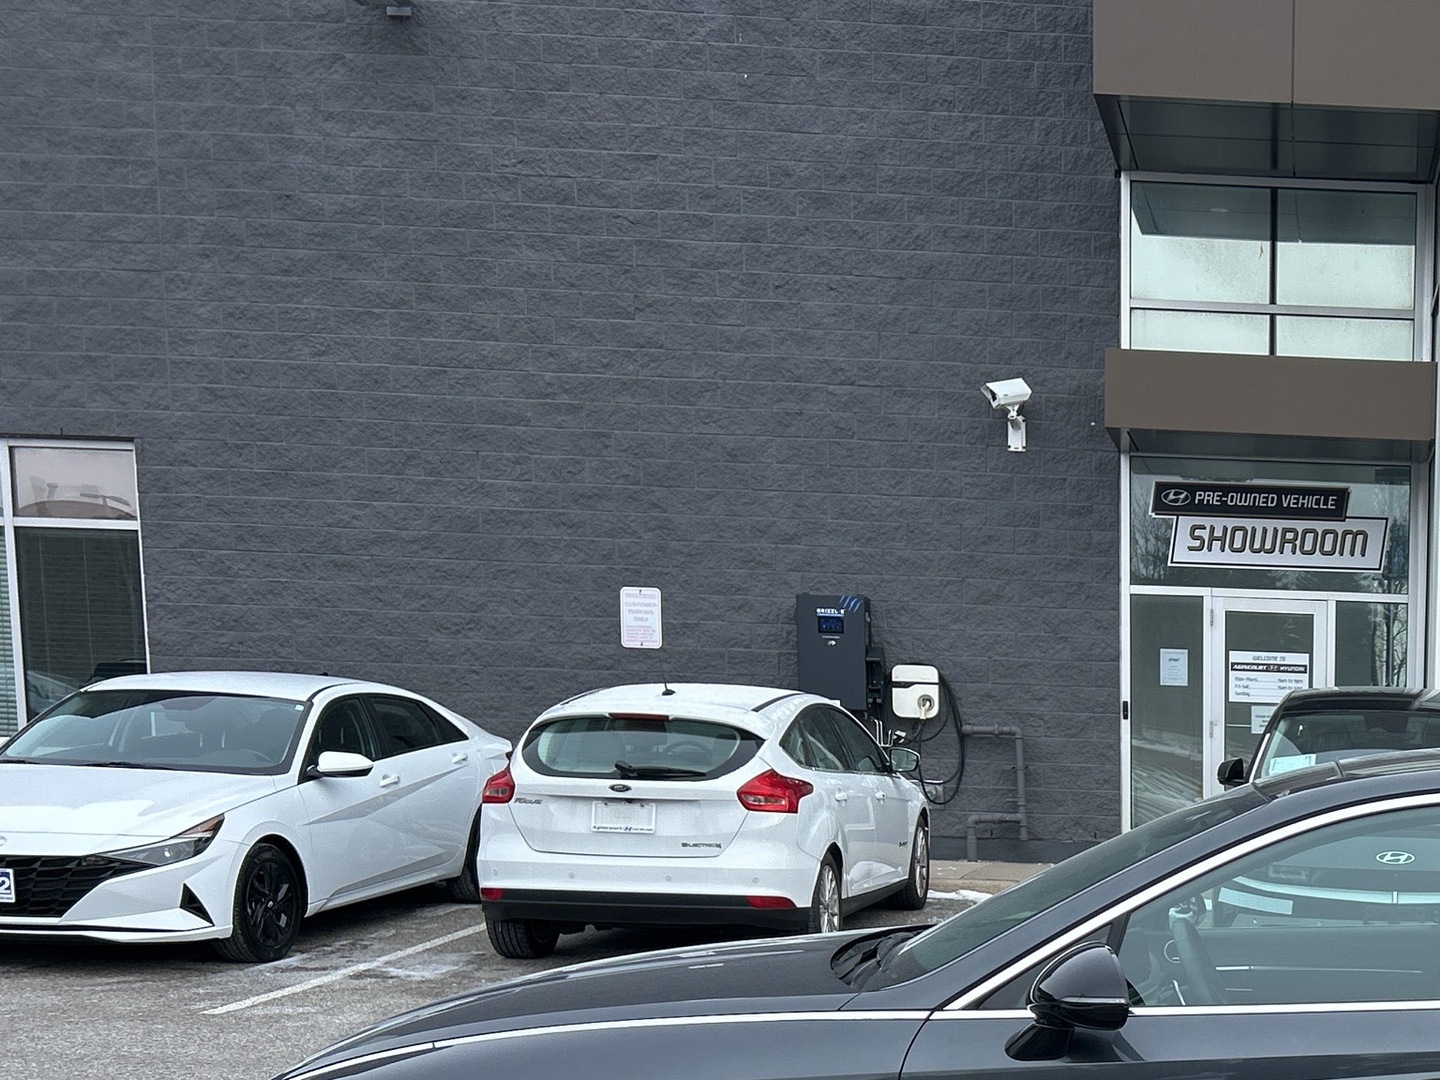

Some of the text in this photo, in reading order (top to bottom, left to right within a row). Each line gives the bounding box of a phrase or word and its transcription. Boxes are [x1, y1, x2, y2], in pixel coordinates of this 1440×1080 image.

[1194, 491, 1337, 509] PRE-OWNED VEHICLE
[1187, 524, 1369, 557] SHOWROOM
